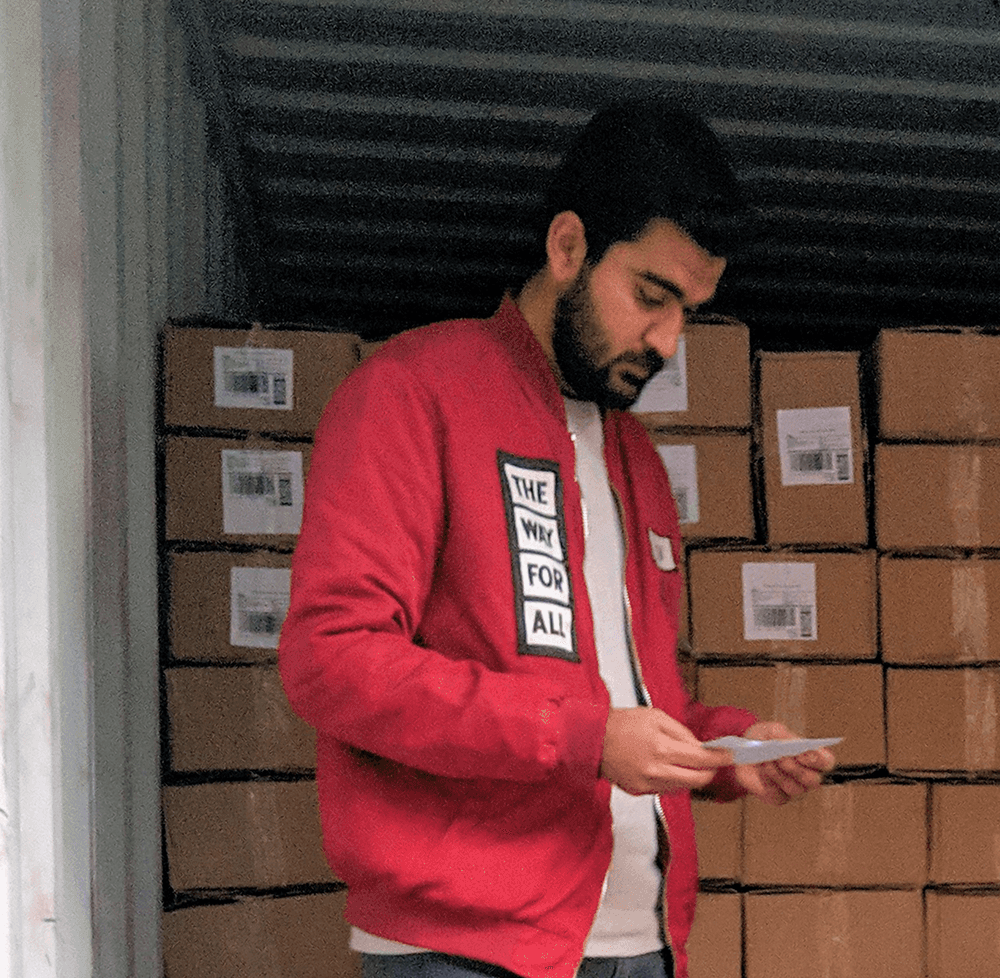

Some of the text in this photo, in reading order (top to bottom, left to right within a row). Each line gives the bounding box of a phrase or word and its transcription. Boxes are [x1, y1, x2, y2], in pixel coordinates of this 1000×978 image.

[511, 475, 548, 505] THE
[520, 517, 554, 548] WAY
[527, 563, 564, 593] FOR
[532, 609, 566, 638] ALL
